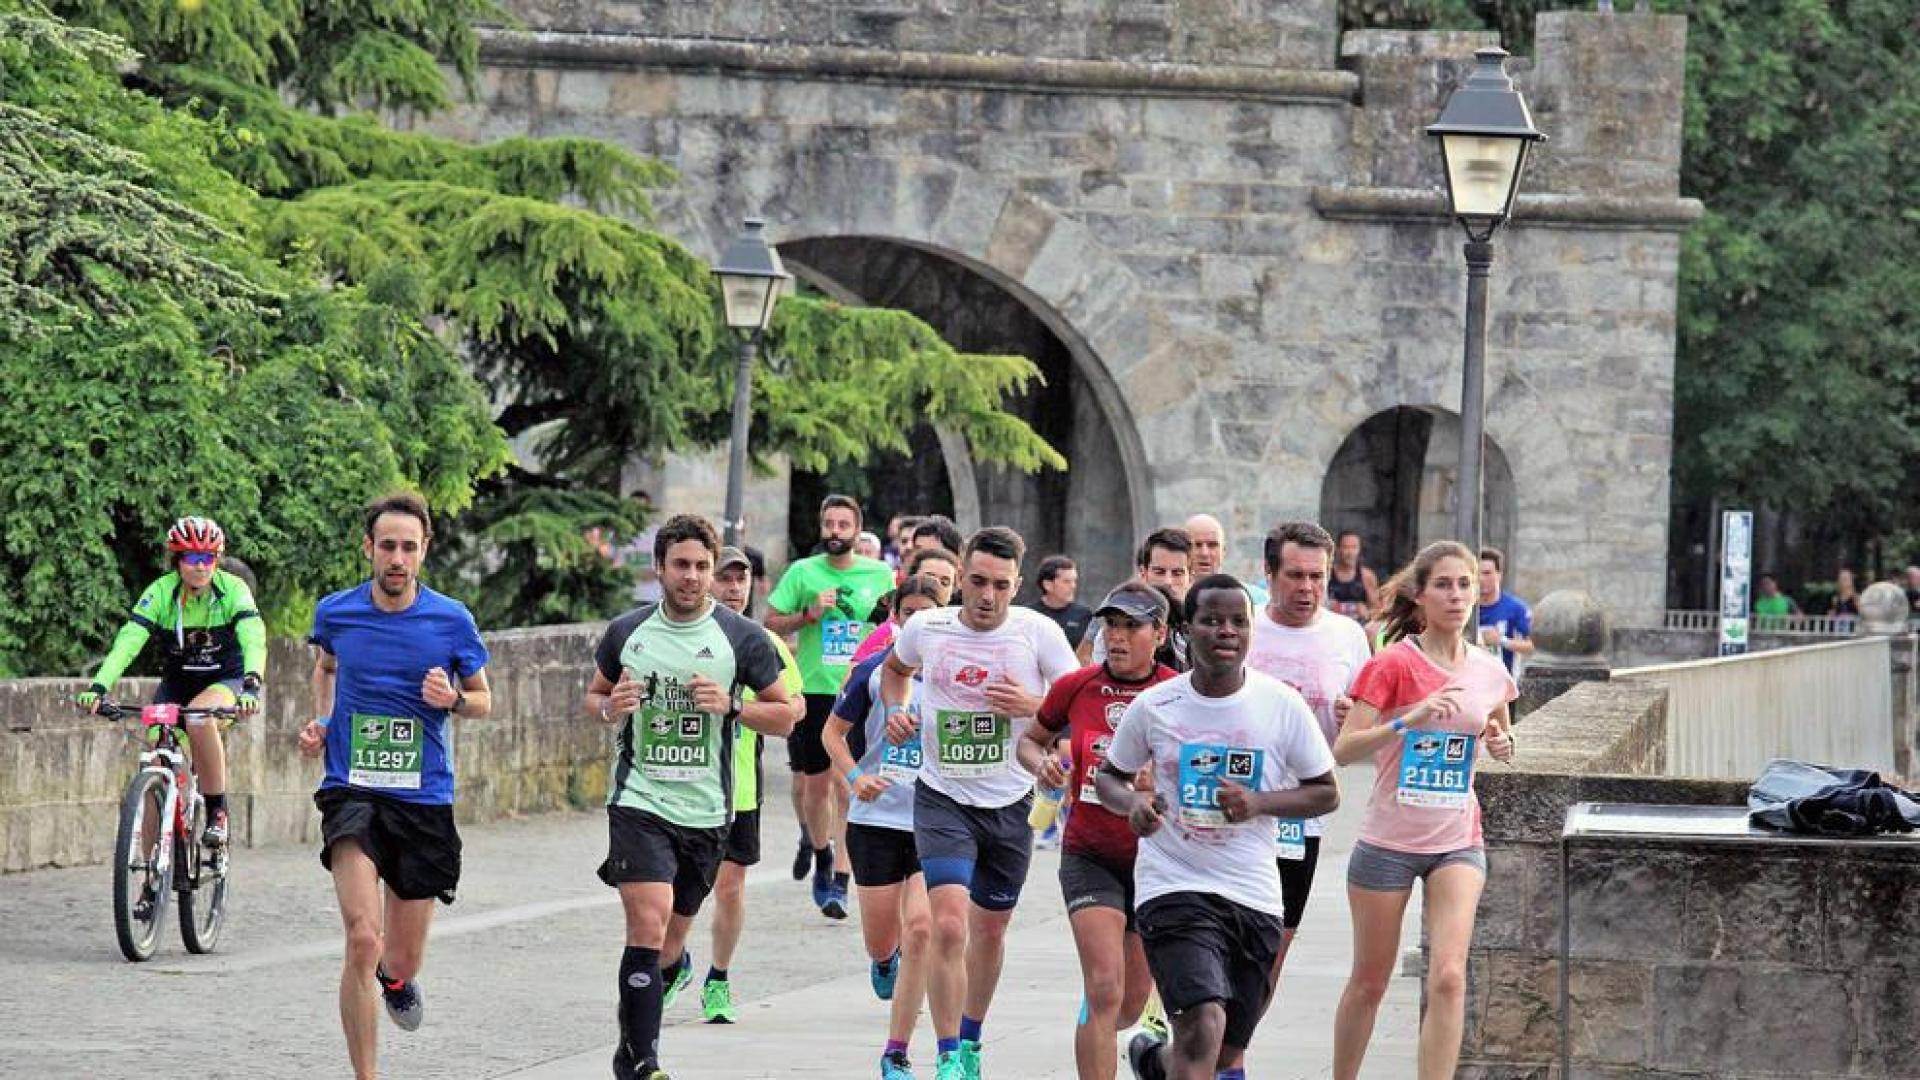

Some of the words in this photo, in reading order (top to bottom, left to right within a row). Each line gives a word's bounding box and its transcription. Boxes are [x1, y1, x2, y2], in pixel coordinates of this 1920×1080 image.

[355, 749, 418, 769] 11297
[645, 744, 705, 763] 10004
[941, 743, 1000, 761] 10870
[1405, 765, 1465, 788] 21161
